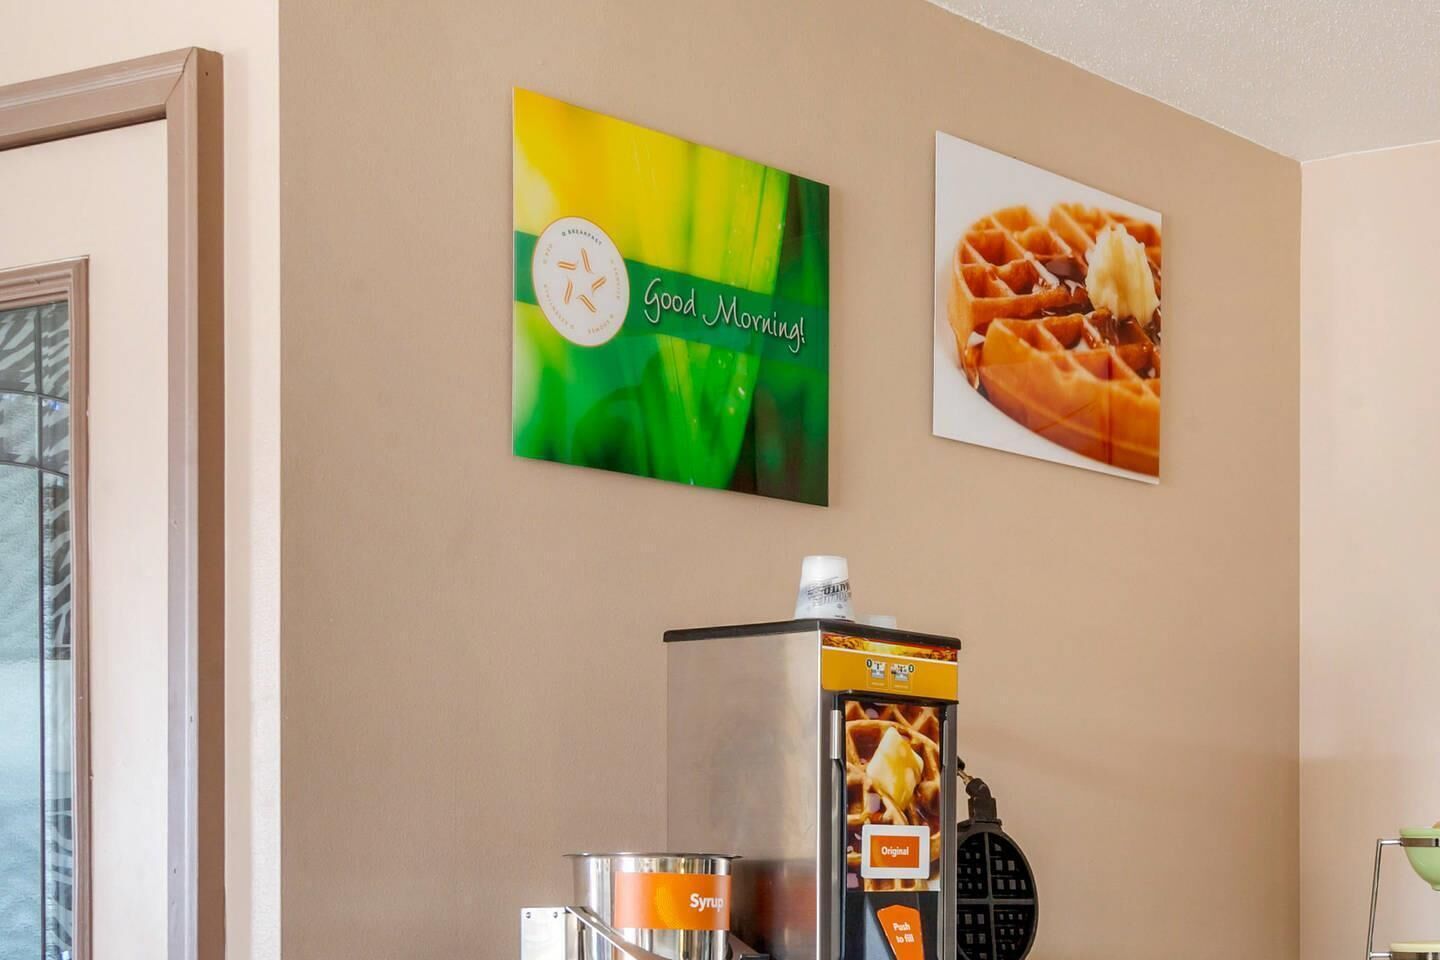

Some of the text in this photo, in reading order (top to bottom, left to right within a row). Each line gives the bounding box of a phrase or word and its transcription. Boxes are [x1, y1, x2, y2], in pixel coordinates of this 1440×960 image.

[644, 277, 697, 324] Good
[702, 294, 806, 354] Morning!
[881, 845, 910, 858] Original
[690, 892, 724, 912] Syrup
[893, 921, 911, 931] Push
[896, 933, 915, 944] to fill
